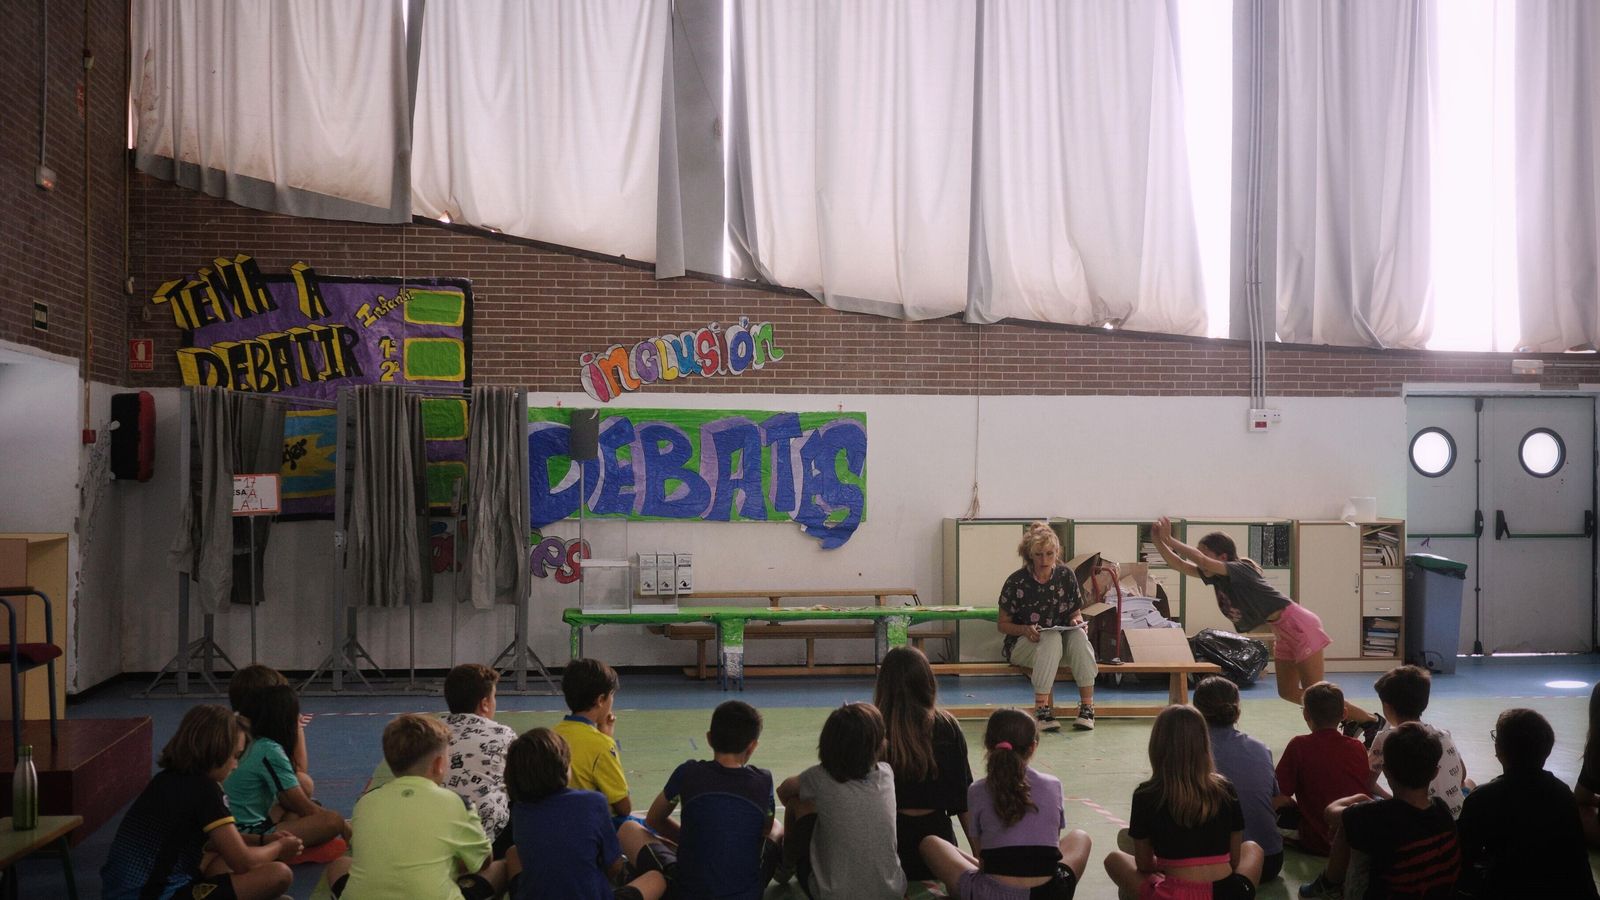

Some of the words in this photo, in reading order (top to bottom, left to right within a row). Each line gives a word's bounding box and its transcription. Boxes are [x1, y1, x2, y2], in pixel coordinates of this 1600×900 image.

[152, 253, 279, 330] TEMA
[289, 261, 333, 321] A
[176, 323, 364, 393] DEBATIR
[529, 412, 867, 551] DEBATES
